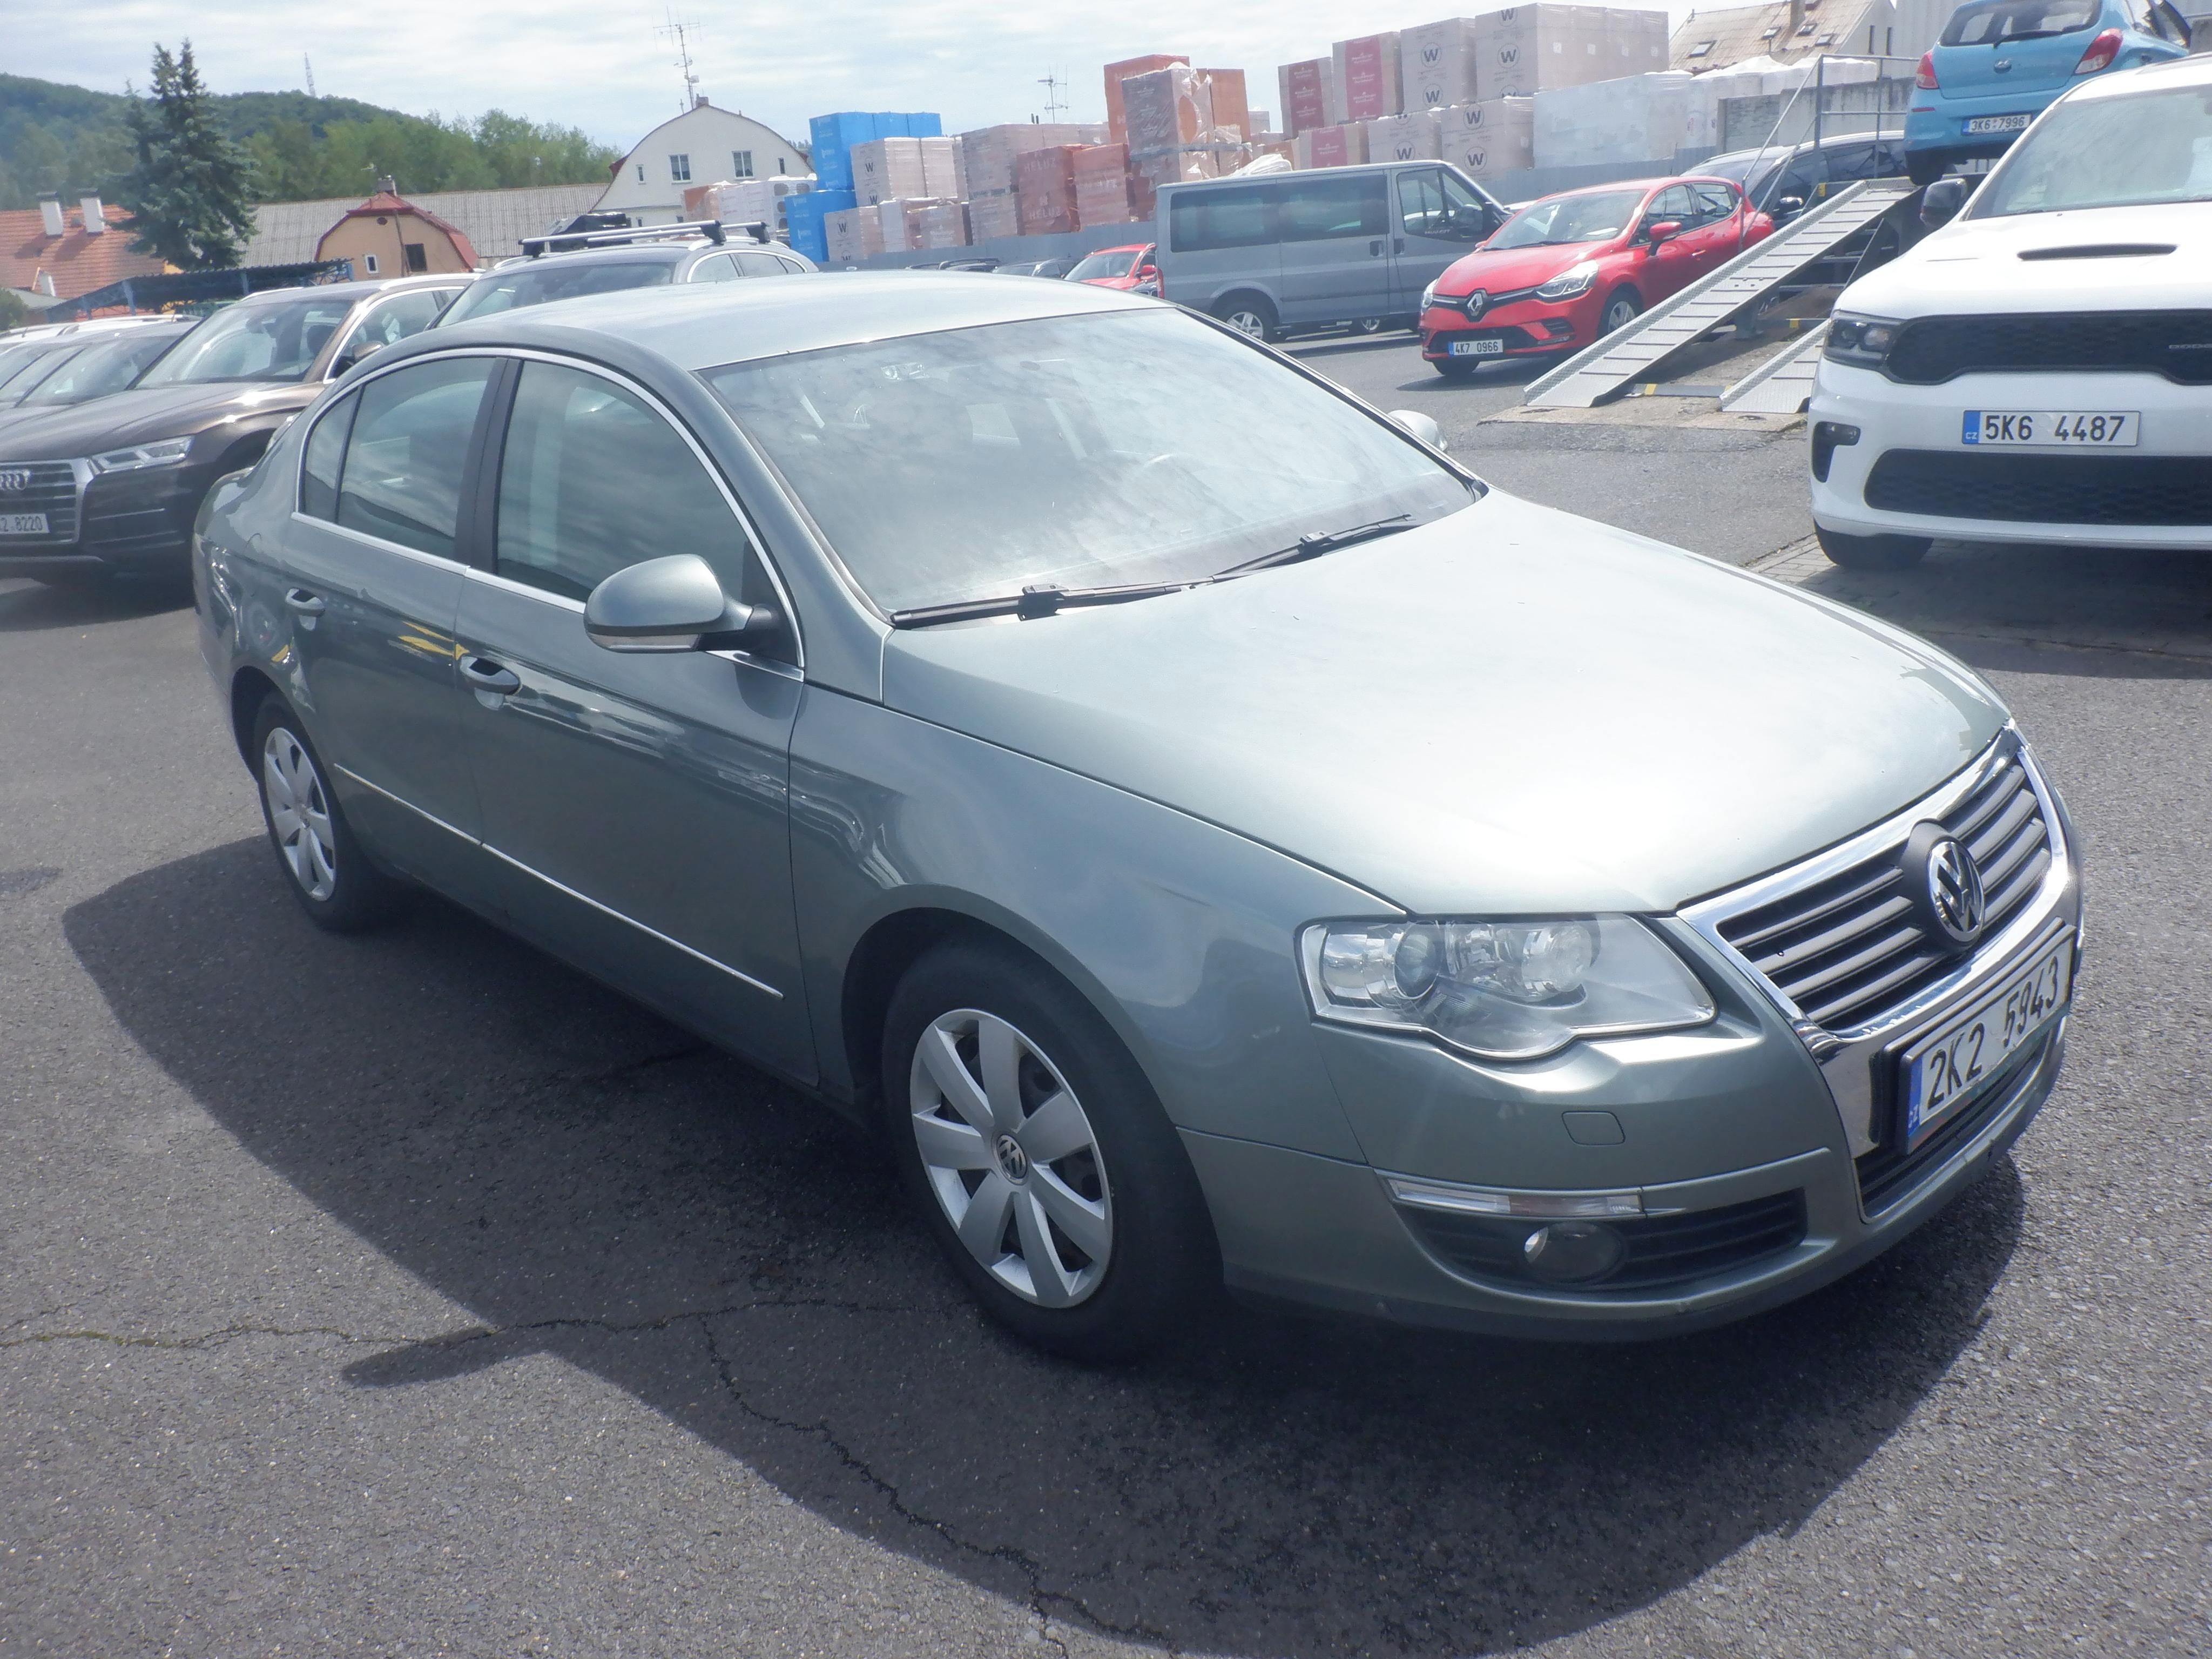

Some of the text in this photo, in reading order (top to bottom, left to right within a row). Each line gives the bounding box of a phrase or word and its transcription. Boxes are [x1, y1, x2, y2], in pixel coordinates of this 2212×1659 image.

[1424, 49, 1439, 62] W
[1500, 49, 1516, 63] W
[1425, 90, 1440, 103] W
[1466, 110, 1481, 124] W
[1971, 116, 2025, 131] 3K6 7996
[1396, 147, 1412, 160] W
[1467, 153, 1484, 166] W
[865, 162, 874, 173] W
[869, 195, 878, 205] W
[838, 222, 847, 233] W
[1455, 343, 1470, 354] 4K7
[1476, 341, 1499, 353] 0966
[1985, 415, 2125, 442] 5K6 4487
[1927, 955, 2058, 1110] 2K2 5943
